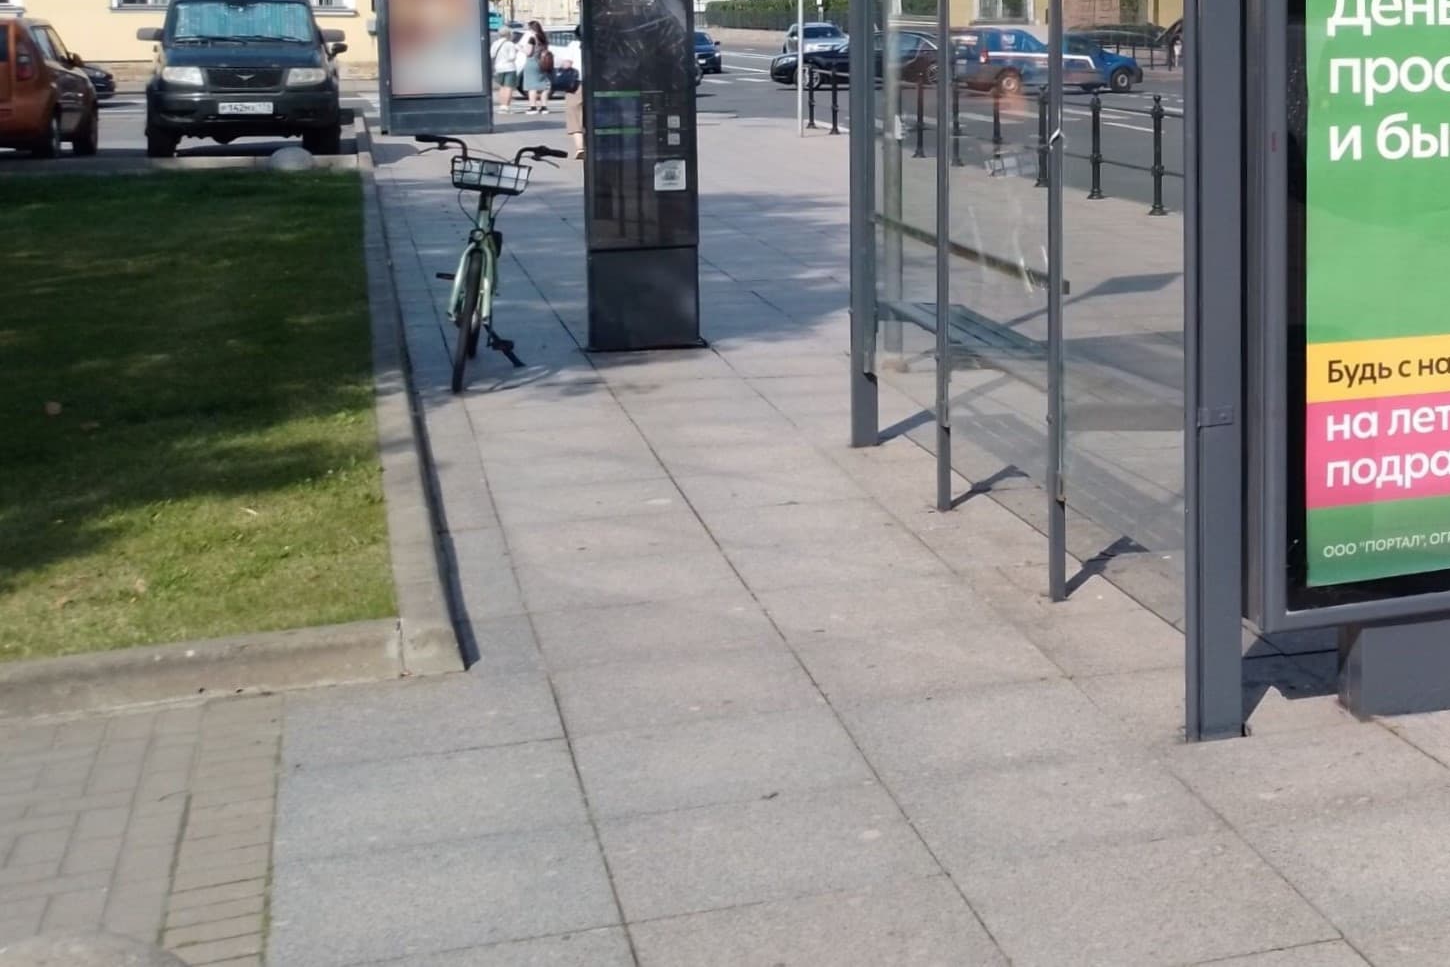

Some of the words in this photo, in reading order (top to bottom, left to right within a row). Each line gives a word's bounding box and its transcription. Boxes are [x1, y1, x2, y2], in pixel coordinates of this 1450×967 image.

[1329, 125, 1362, 161] и
[1328, 360, 1392, 388] Будь
[1398, 359, 1411, 377] с
[1327, 411, 1378, 441] на
[1323, 542, 1357, 558] ООО
